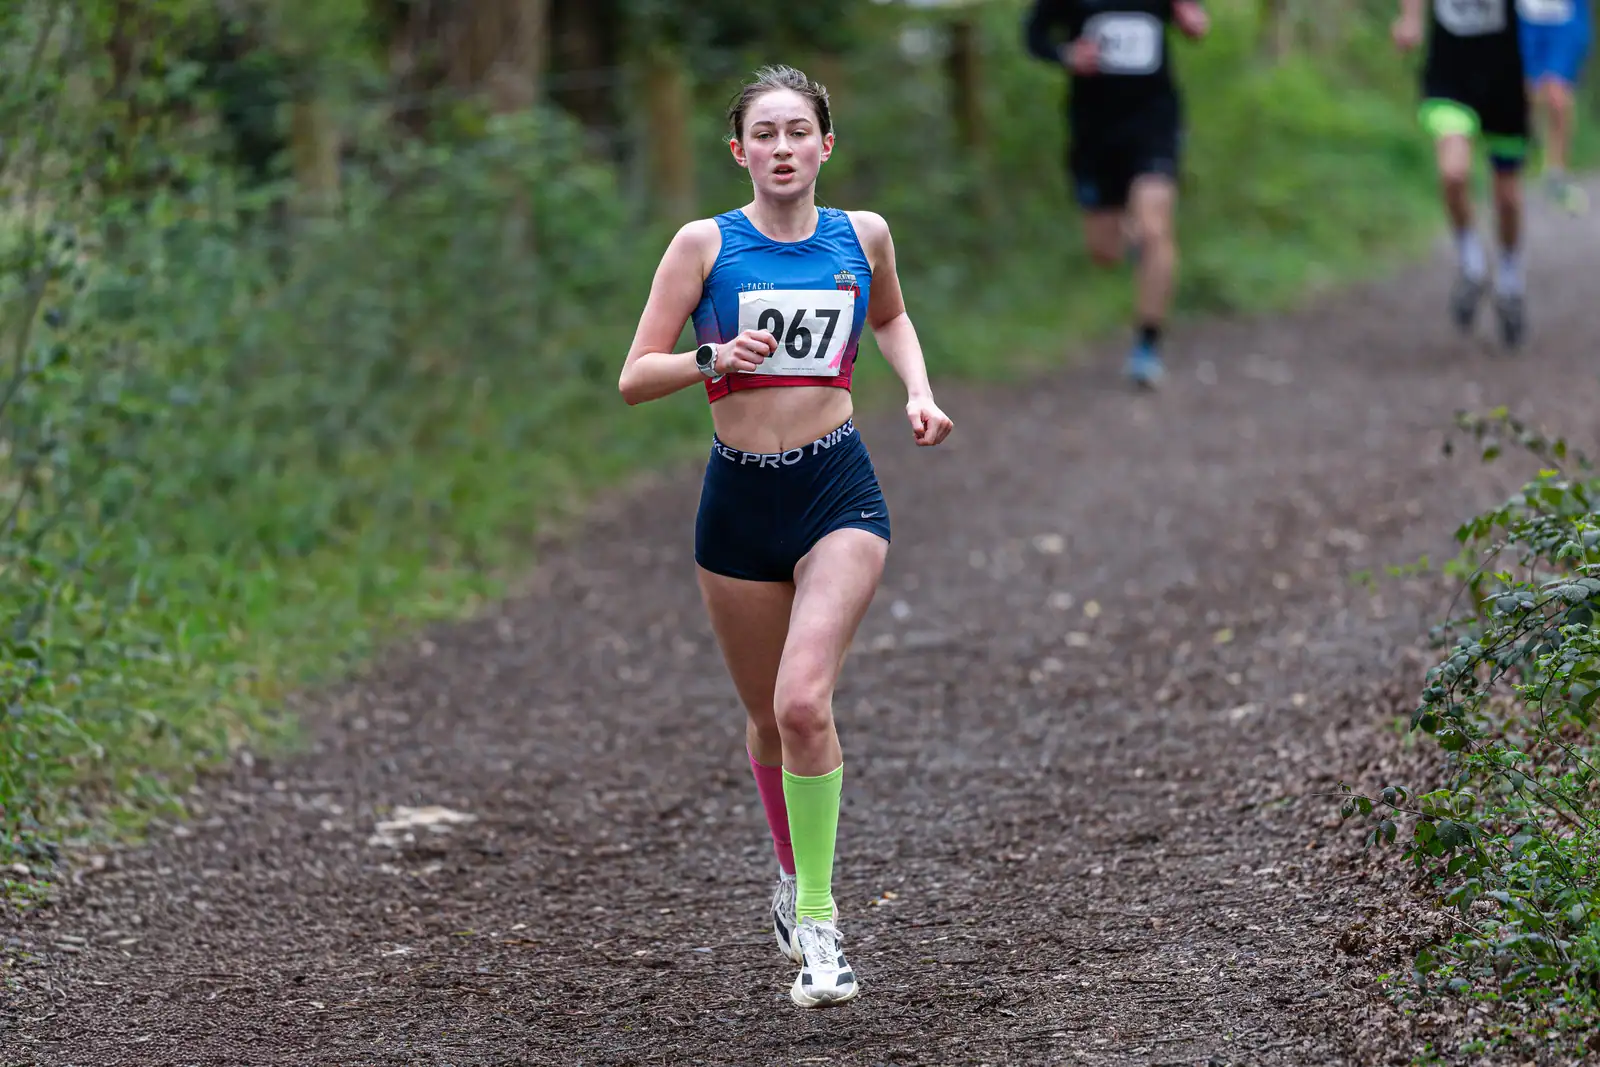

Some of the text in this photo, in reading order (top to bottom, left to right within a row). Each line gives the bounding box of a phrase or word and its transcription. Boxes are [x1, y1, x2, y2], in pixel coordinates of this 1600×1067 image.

[747, 282, 775, 290] TACTIC
[757, 308, 841, 359] 967
[740, 447, 804, 468] PRO
